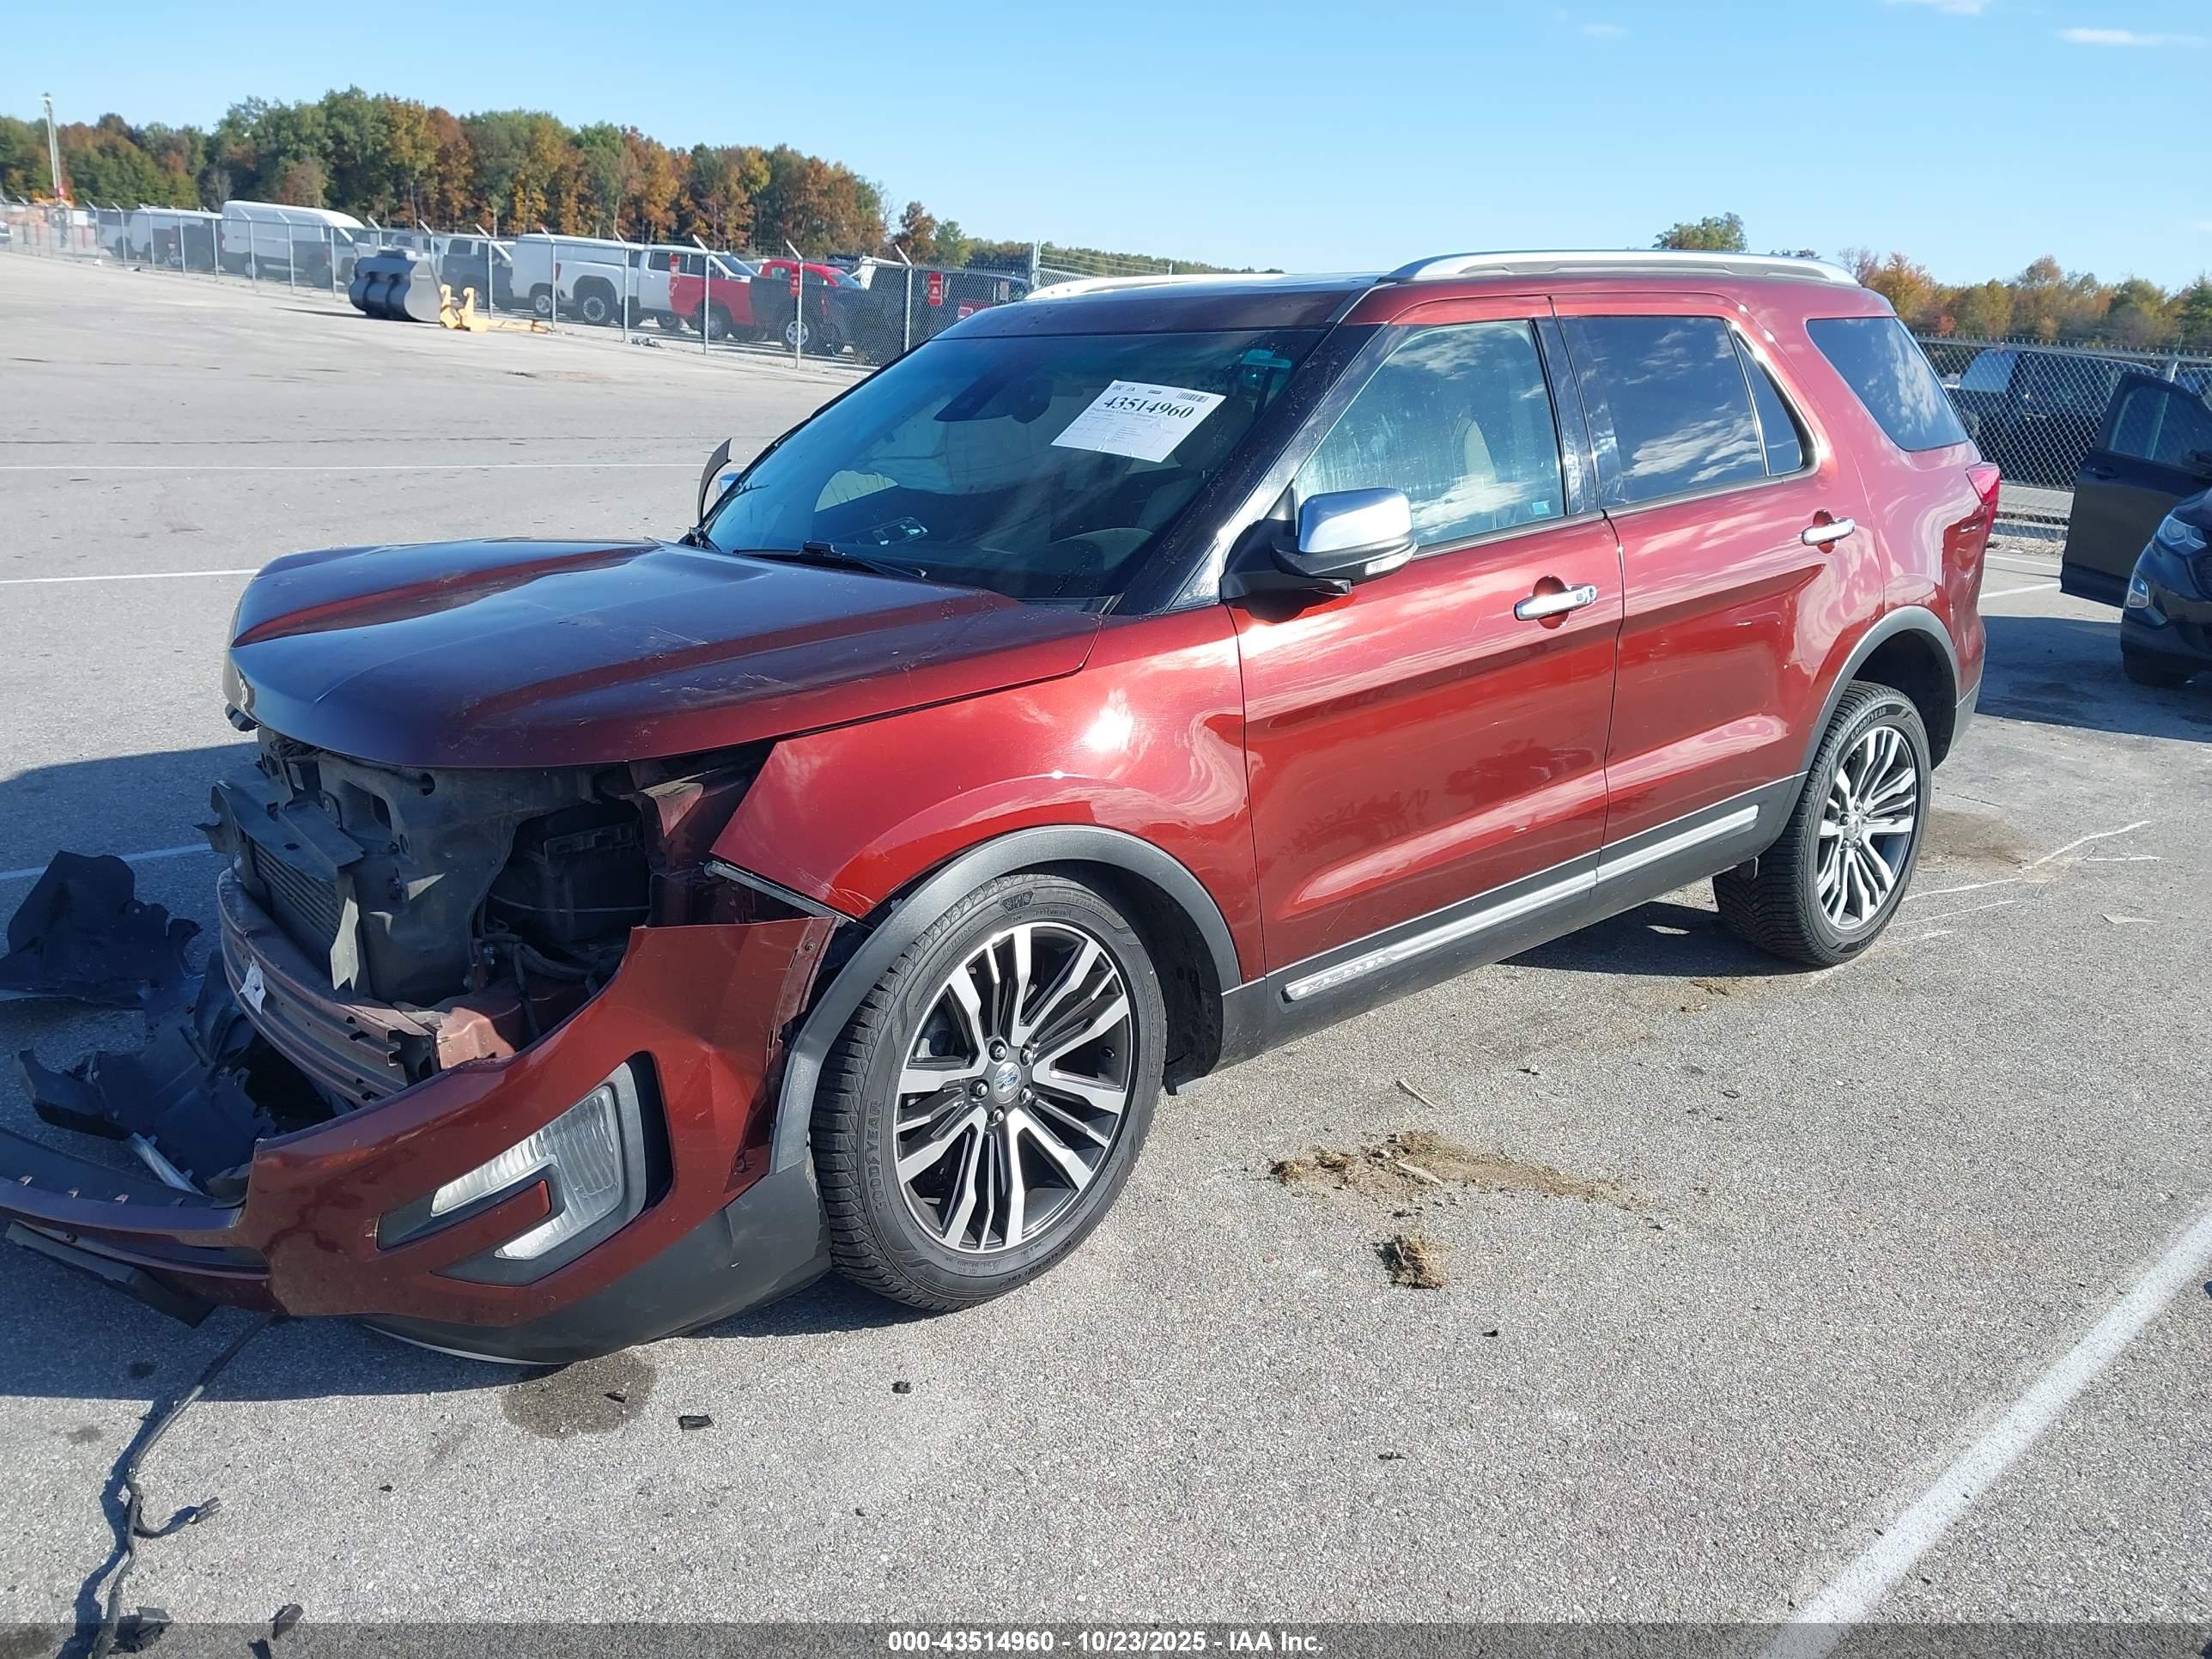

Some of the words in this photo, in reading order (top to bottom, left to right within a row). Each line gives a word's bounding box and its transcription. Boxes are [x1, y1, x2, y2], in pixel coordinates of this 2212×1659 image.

[1103, 396, 1194, 419] 43514960
[1851, 707, 1887, 740] GOODYEAR
[866, 1100, 888, 1213] GOODYEAR
